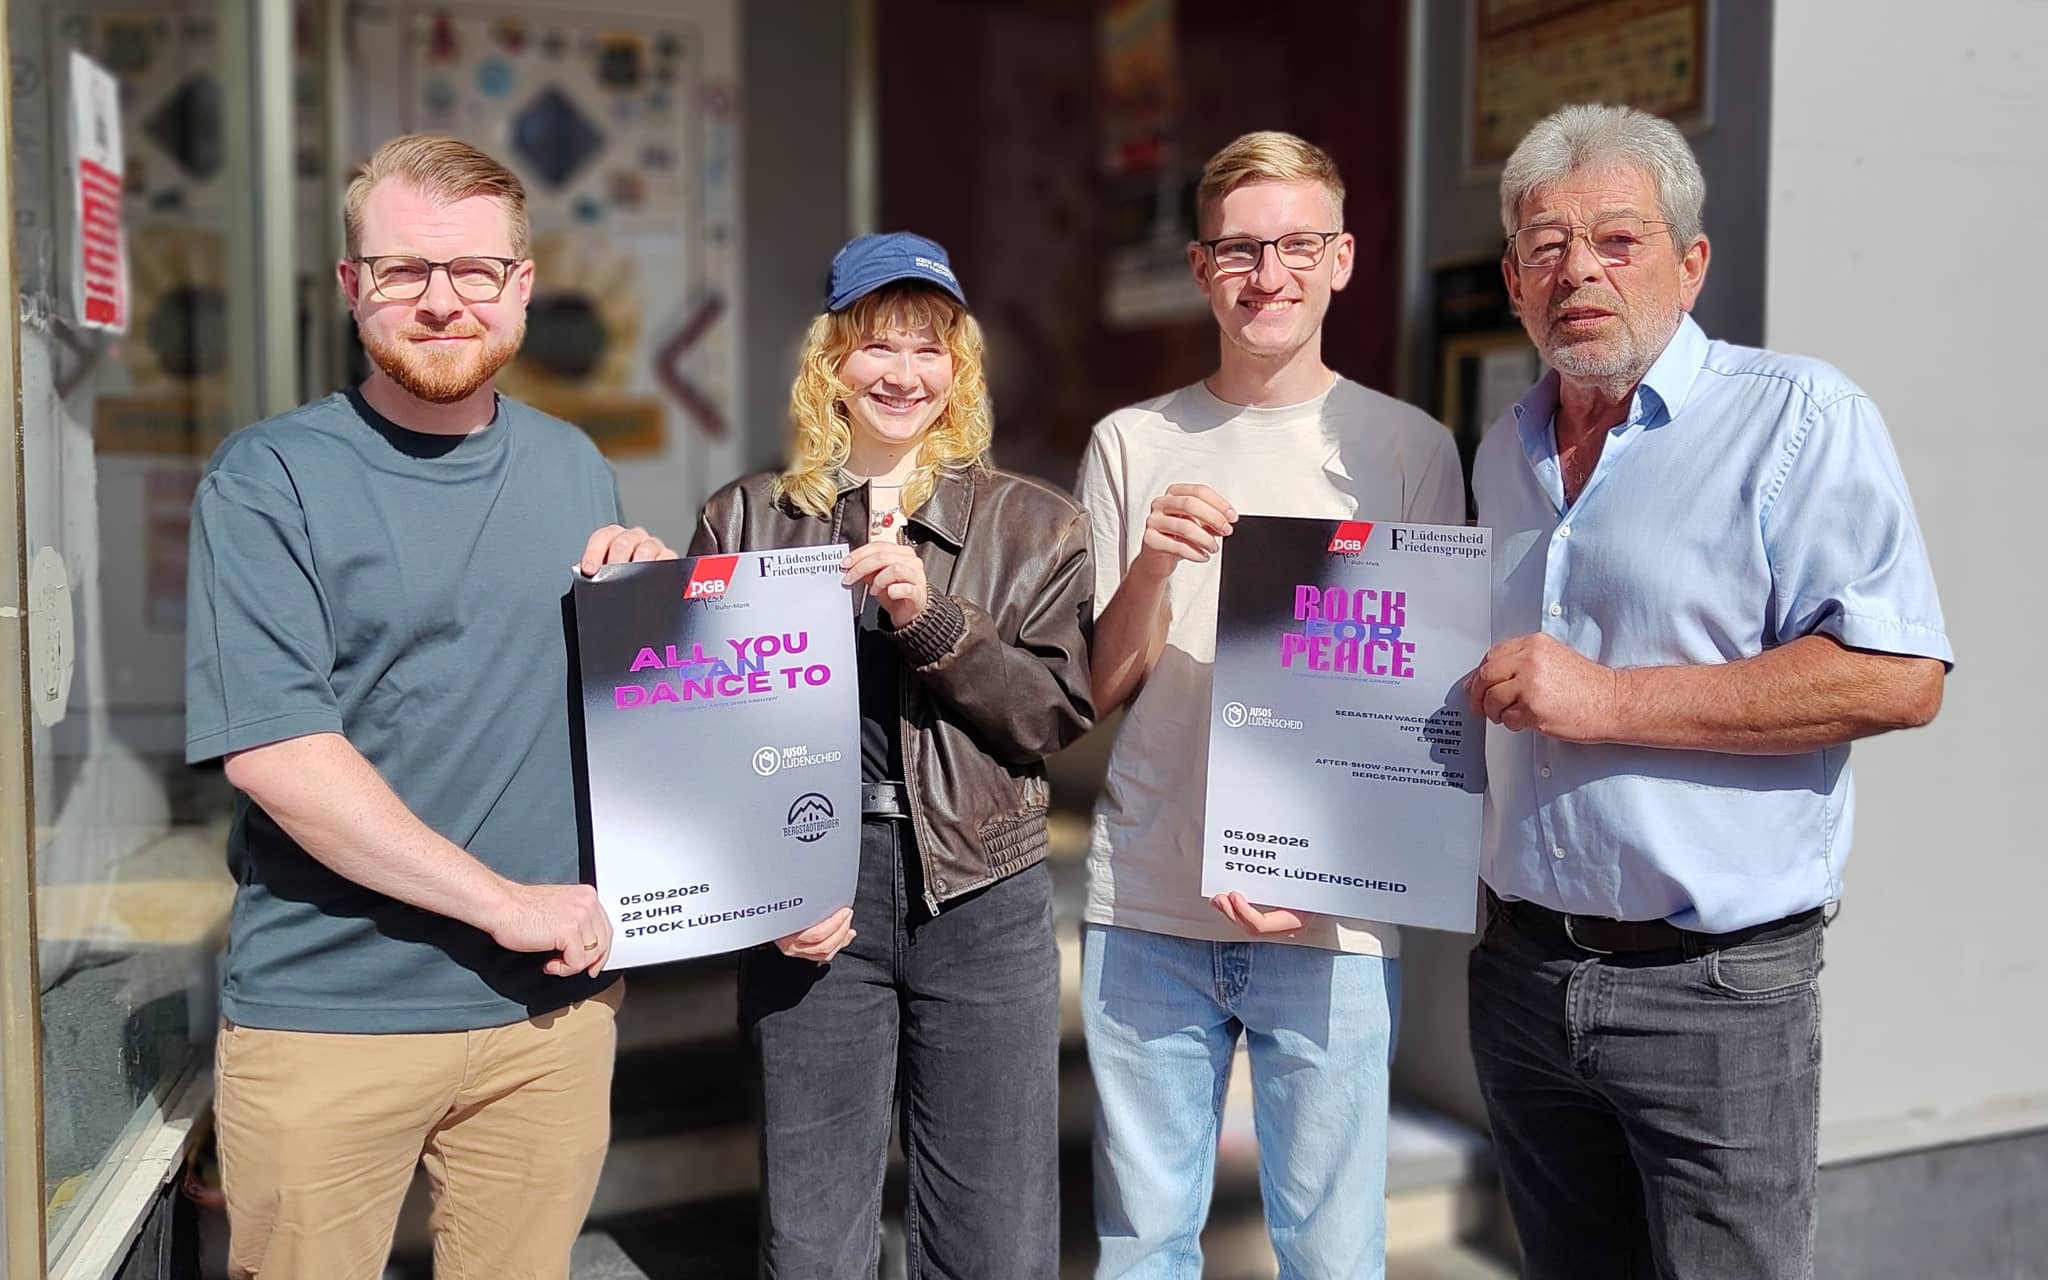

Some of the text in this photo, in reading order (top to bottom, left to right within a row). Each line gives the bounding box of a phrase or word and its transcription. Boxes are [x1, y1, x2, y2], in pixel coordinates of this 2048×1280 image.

[1334, 539, 1361, 551] DGB
[1391, 529, 1487, 557] Friedensgruppe
[1411, 530, 1483, 544] Lüdenscheid
[757, 556, 842, 578] Friedensgrupp
[777, 550, 843, 566] Lüdenscheid
[691, 579, 725, 596] DGB
[714, 602, 750, 611] Ruhr-Mark
[1294, 585, 1406, 627] ROCK
[1306, 619, 1402, 643] FOR
[630, 631, 808, 672] ALL YOU
[1280, 633, 1415, 678] PEACE
[679, 655, 765, 681] CAN
[615, 671, 773, 711] DANCE
[780, 664, 831, 688] TO
[1248, 707, 1272, 718] JUSOS
[1335, 710, 1463, 727] SEBASTIAN WAGEMEYER
[1400, 725, 1421, 733] NOT
[1445, 729, 1462, 737] ME
[1417, 736, 1462, 746] EXORBIT
[782, 745, 808, 759] JUSOS
[1315, 758, 1465, 779] AFTER-SHOW-PARTY MIT DEN
[1352, 771, 1464, 788] BERGSTADTBRÜDERN
[1223, 829, 1310, 848] 05.09.2026
[1222, 845, 1277, 860] 19 UHR
[1224, 861, 1407, 893] STOCK LÜDENSCHEID
[619, 883, 711, 906] 05.09.2026
[621, 905, 683, 922] 22 UHR
[625, 897, 803, 938] STOCK LÜDENSCHEID
